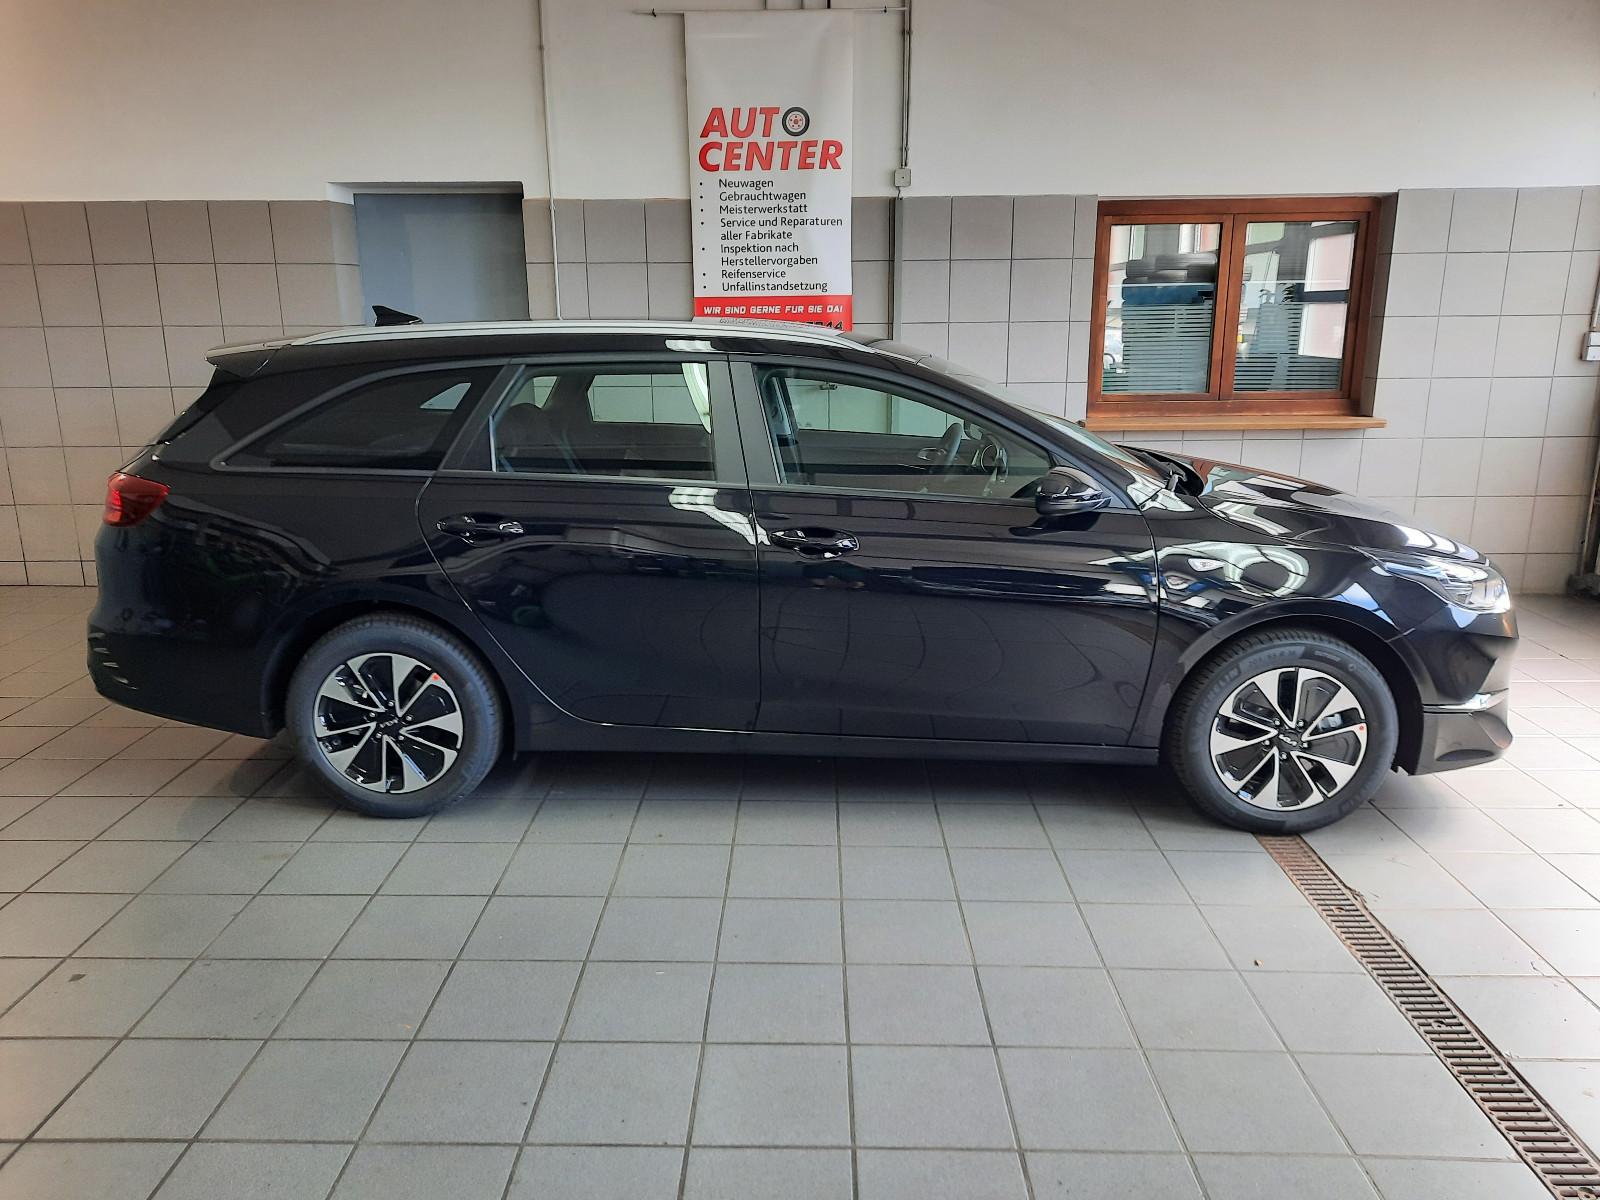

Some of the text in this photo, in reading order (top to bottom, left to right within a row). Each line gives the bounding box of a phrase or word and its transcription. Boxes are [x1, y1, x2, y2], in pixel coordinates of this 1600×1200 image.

[698, 140, 844, 172] CENTER
[718, 179, 774, 190] Neuwagen
[719, 191, 807, 203] Gebrauchtwagen
[719, 204, 808, 215] Meisterwerkstatt
[720, 216, 843, 228] Service und Reparaturen
[720, 230, 793, 240] aller Fabrikate
[720, 243, 799, 256] Inspektion nach
[721, 256, 818, 268] Herstellervorgaben
[721, 269, 786, 279] Reifenservice
[722, 281, 828, 292] Unfallinstandsetzung
[703, 306, 721, 315] WIR
[724, 306, 746, 315] SIND
[750, 306, 781, 314] GERNE
[807, 305, 823, 314] SIE
